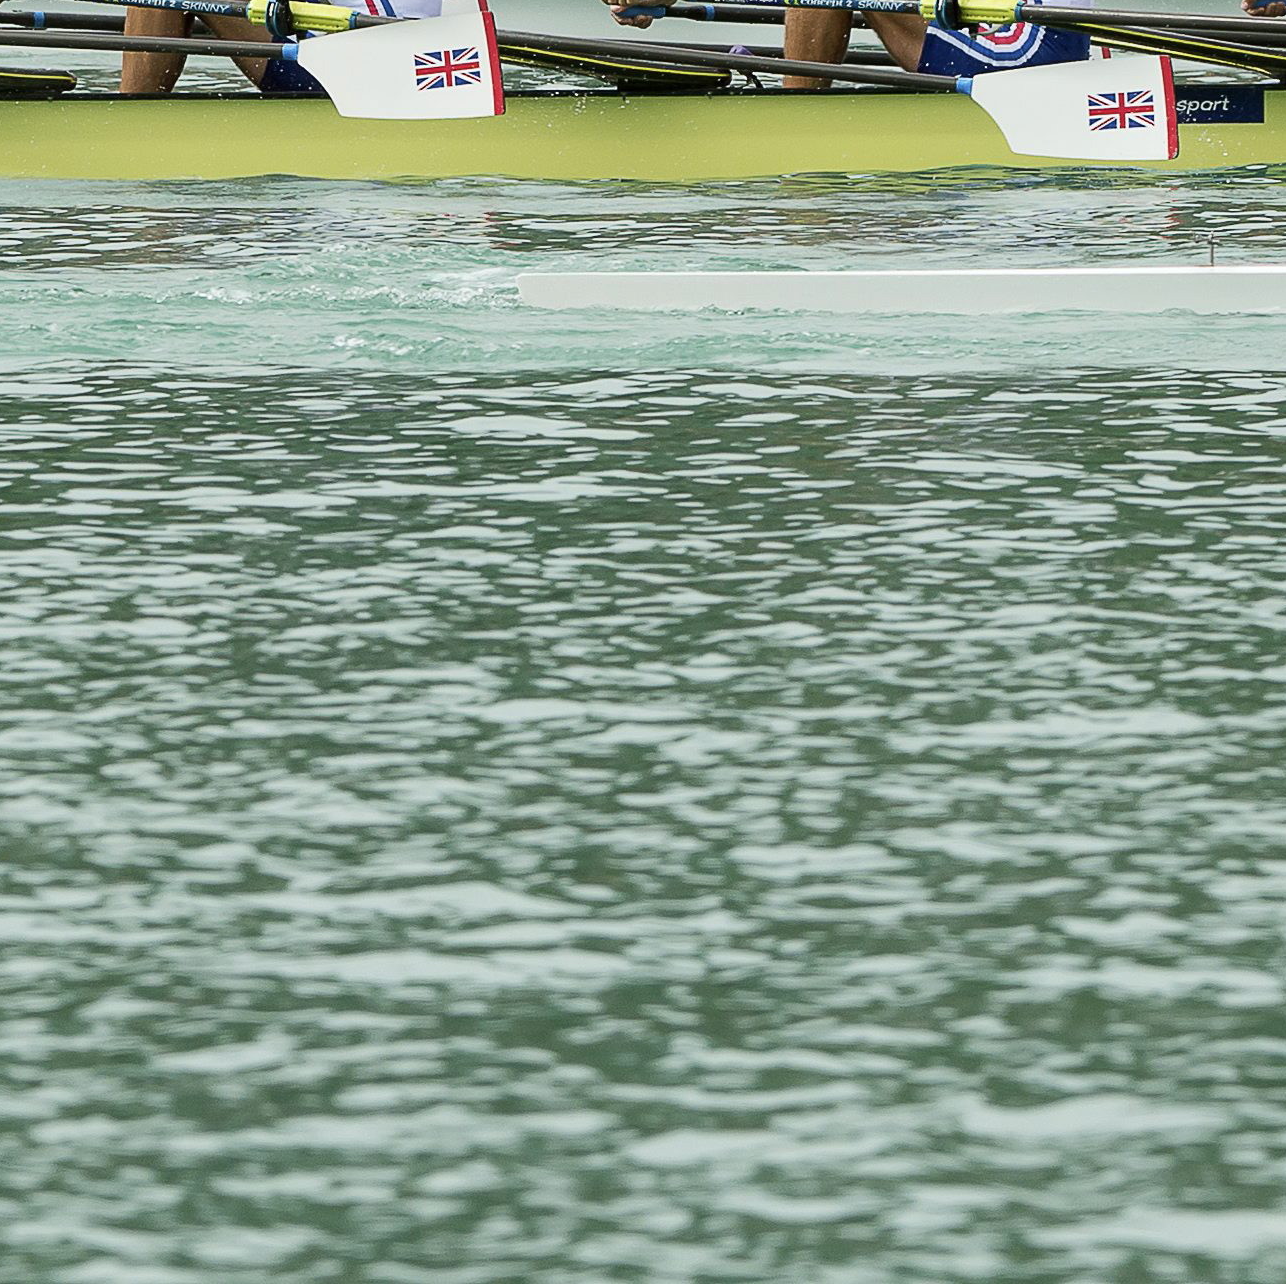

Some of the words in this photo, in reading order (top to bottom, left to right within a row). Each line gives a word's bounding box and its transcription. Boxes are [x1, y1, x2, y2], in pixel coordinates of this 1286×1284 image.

[169, 0, 177, 8] 2
[181, 0, 230, 14] SKINNY
[846, 0, 853, 8] 2
[857, 1, 904, 12] SKINNY
[1176, 97, 1230, 115] sport
